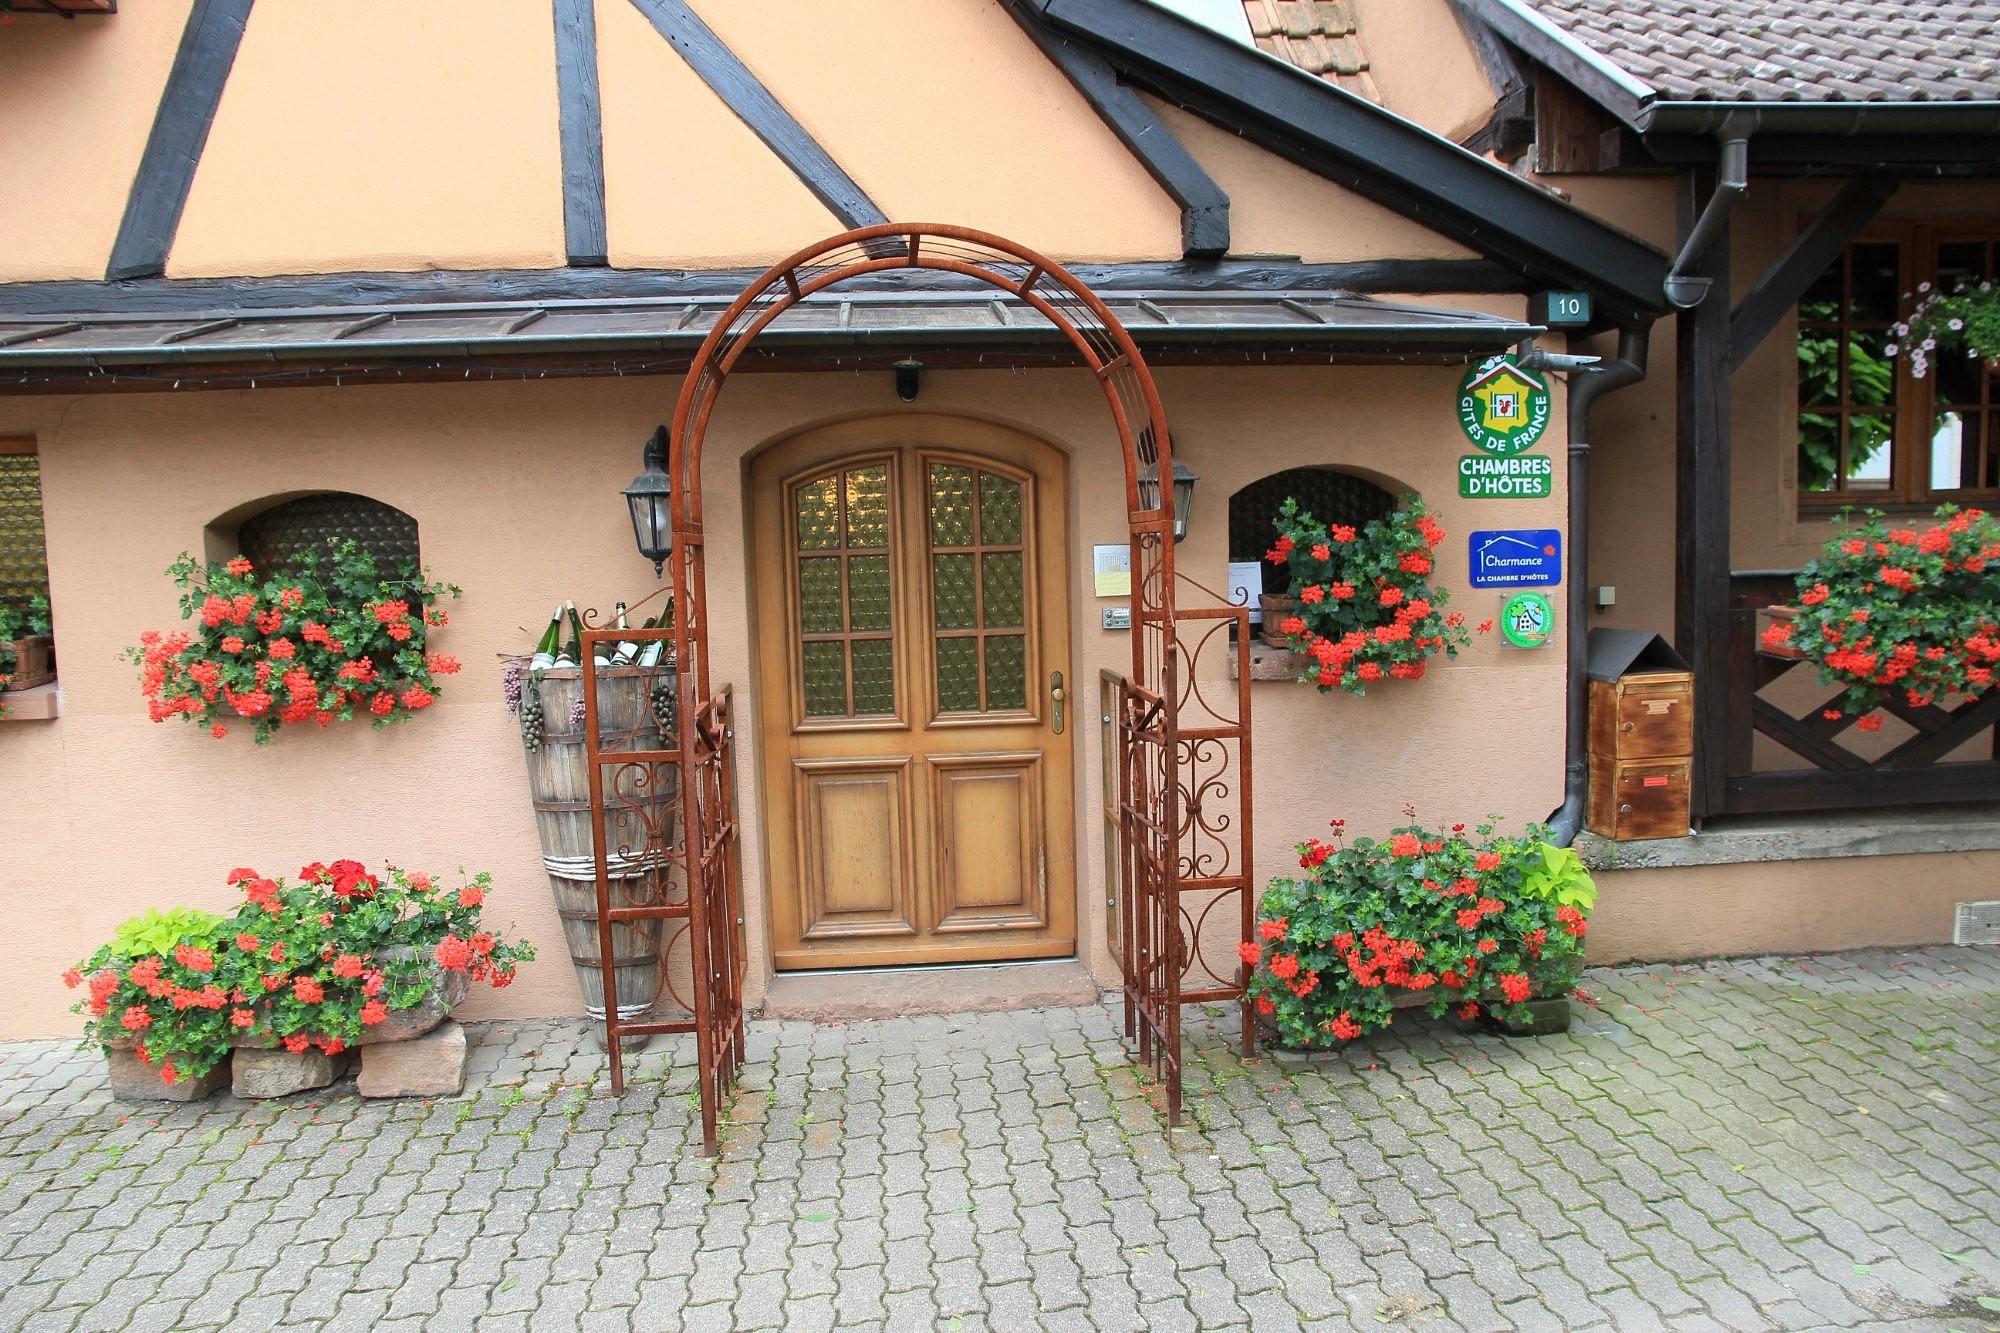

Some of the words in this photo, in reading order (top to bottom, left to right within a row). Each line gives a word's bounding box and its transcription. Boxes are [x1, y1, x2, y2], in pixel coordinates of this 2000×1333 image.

[1559, 298, 1580, 315] 10
[1461, 396, 1485, 440] GITES
[1486, 436, 1507, 452] DE
[1512, 396, 1547, 450] FRANCE
[1460, 458, 1551, 475] CHAMBRES
[1469, 475, 1542, 494] D'HÔTES
[1485, 555, 1543, 567] Charmance
[1520, 573, 1549, 581] D'HÔTES
